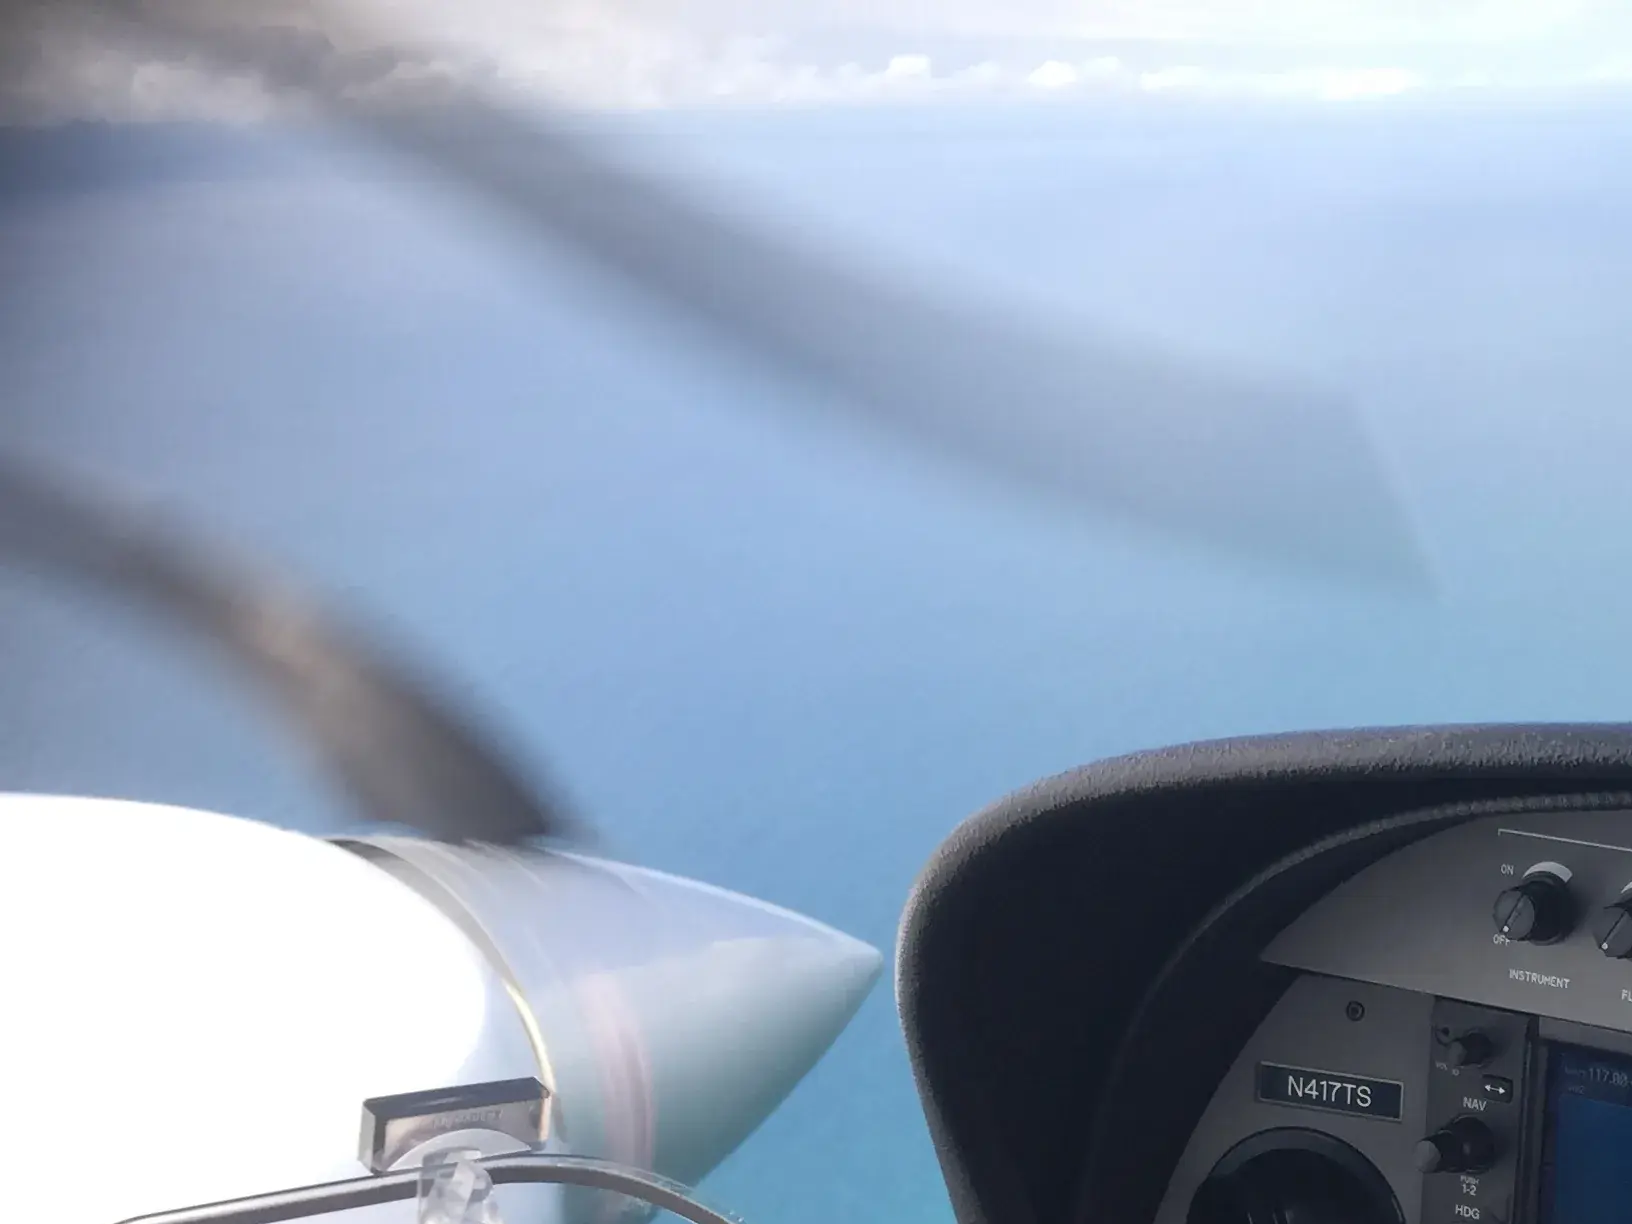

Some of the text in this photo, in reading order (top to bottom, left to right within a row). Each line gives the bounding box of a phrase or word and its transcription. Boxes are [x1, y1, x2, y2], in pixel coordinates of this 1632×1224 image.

[1509, 968, 1570, 989] INSTRUMENT
[1287, 1074, 1372, 1108] N417TS
[1463, 1096, 1487, 1112] NAV
[1455, 1204, 1480, 1219] HDG
